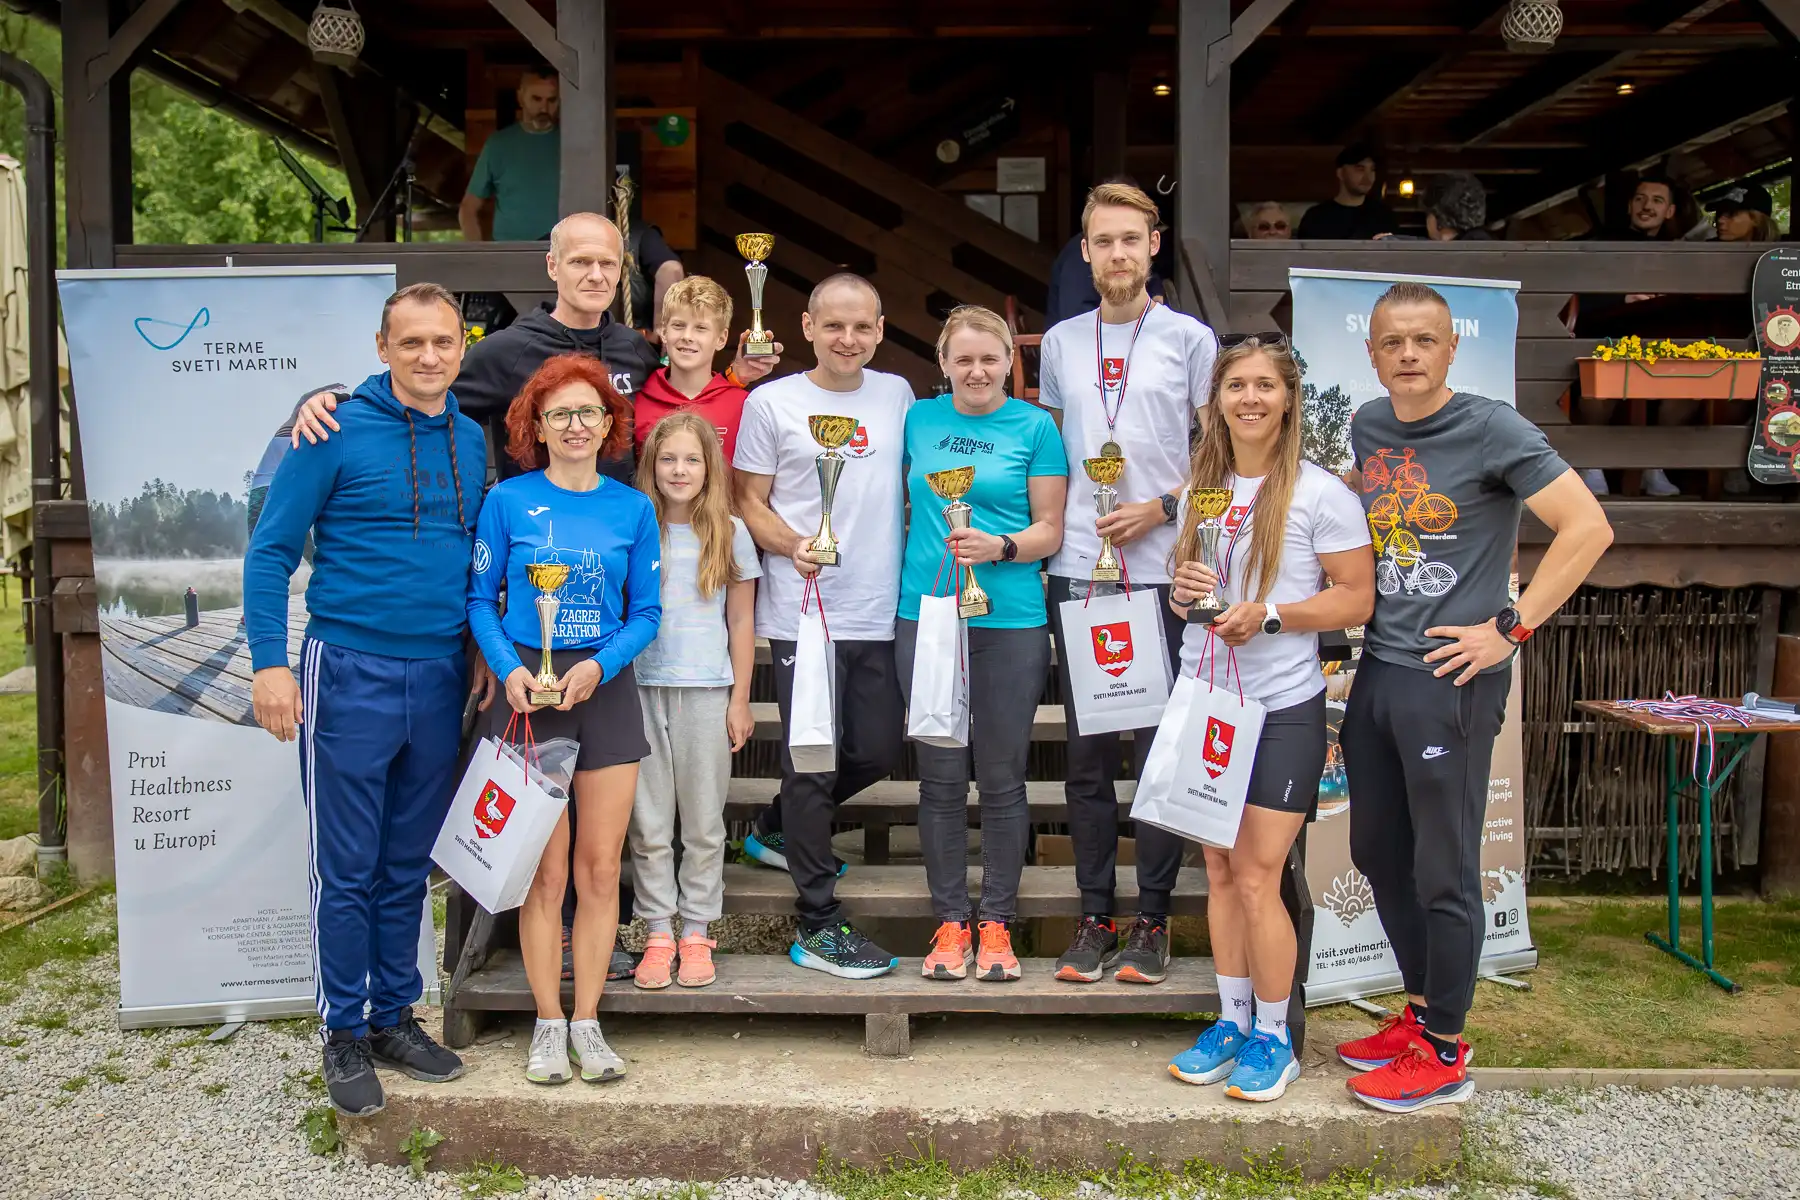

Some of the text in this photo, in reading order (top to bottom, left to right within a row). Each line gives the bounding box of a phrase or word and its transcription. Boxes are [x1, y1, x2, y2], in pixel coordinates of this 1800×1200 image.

[203, 341, 265, 355] TERME
[172, 357, 298, 373] SVETI MARTIN
[952, 436, 995, 451] ZRINSKI
[949, 445, 977, 456] HALF
[561, 609, 601, 623] ZAGREB
[552, 624, 601, 638] ARATHON
[1107, 690, 1126, 698] MARTIN
[1134, 687, 1147, 695] MURI
[1426, 745, 1444, 754] NIKE
[128, 750, 166, 769] Prvi
[130, 775, 233, 797] Healthness
[1489, 777, 1511, 788] vnog
[1487, 789, 1513, 803] ljenja
[132, 806, 192, 824] Resort
[1485, 817, 1513, 828] active
[134, 829, 217, 851] u Europi
[1490, 830, 1513, 843] living
[276, 913, 311, 922] APARTMEN
[215, 924, 241, 932] TEMPLE
[272, 921, 307, 929] AQUAPARK
[207, 933, 245, 941] KONGRESNI
[276, 929, 311, 937] CONFEREN
[1484, 928, 1520, 941] etimartin
[237, 938, 278, 946] HEALTHNESS
[281, 943, 312, 951] POLYCLIN
[1316, 962, 1329, 970] TEL:
[1330, 959, 1346, 967] +385
[220, 974, 315, 988] www.termesvetimarti
